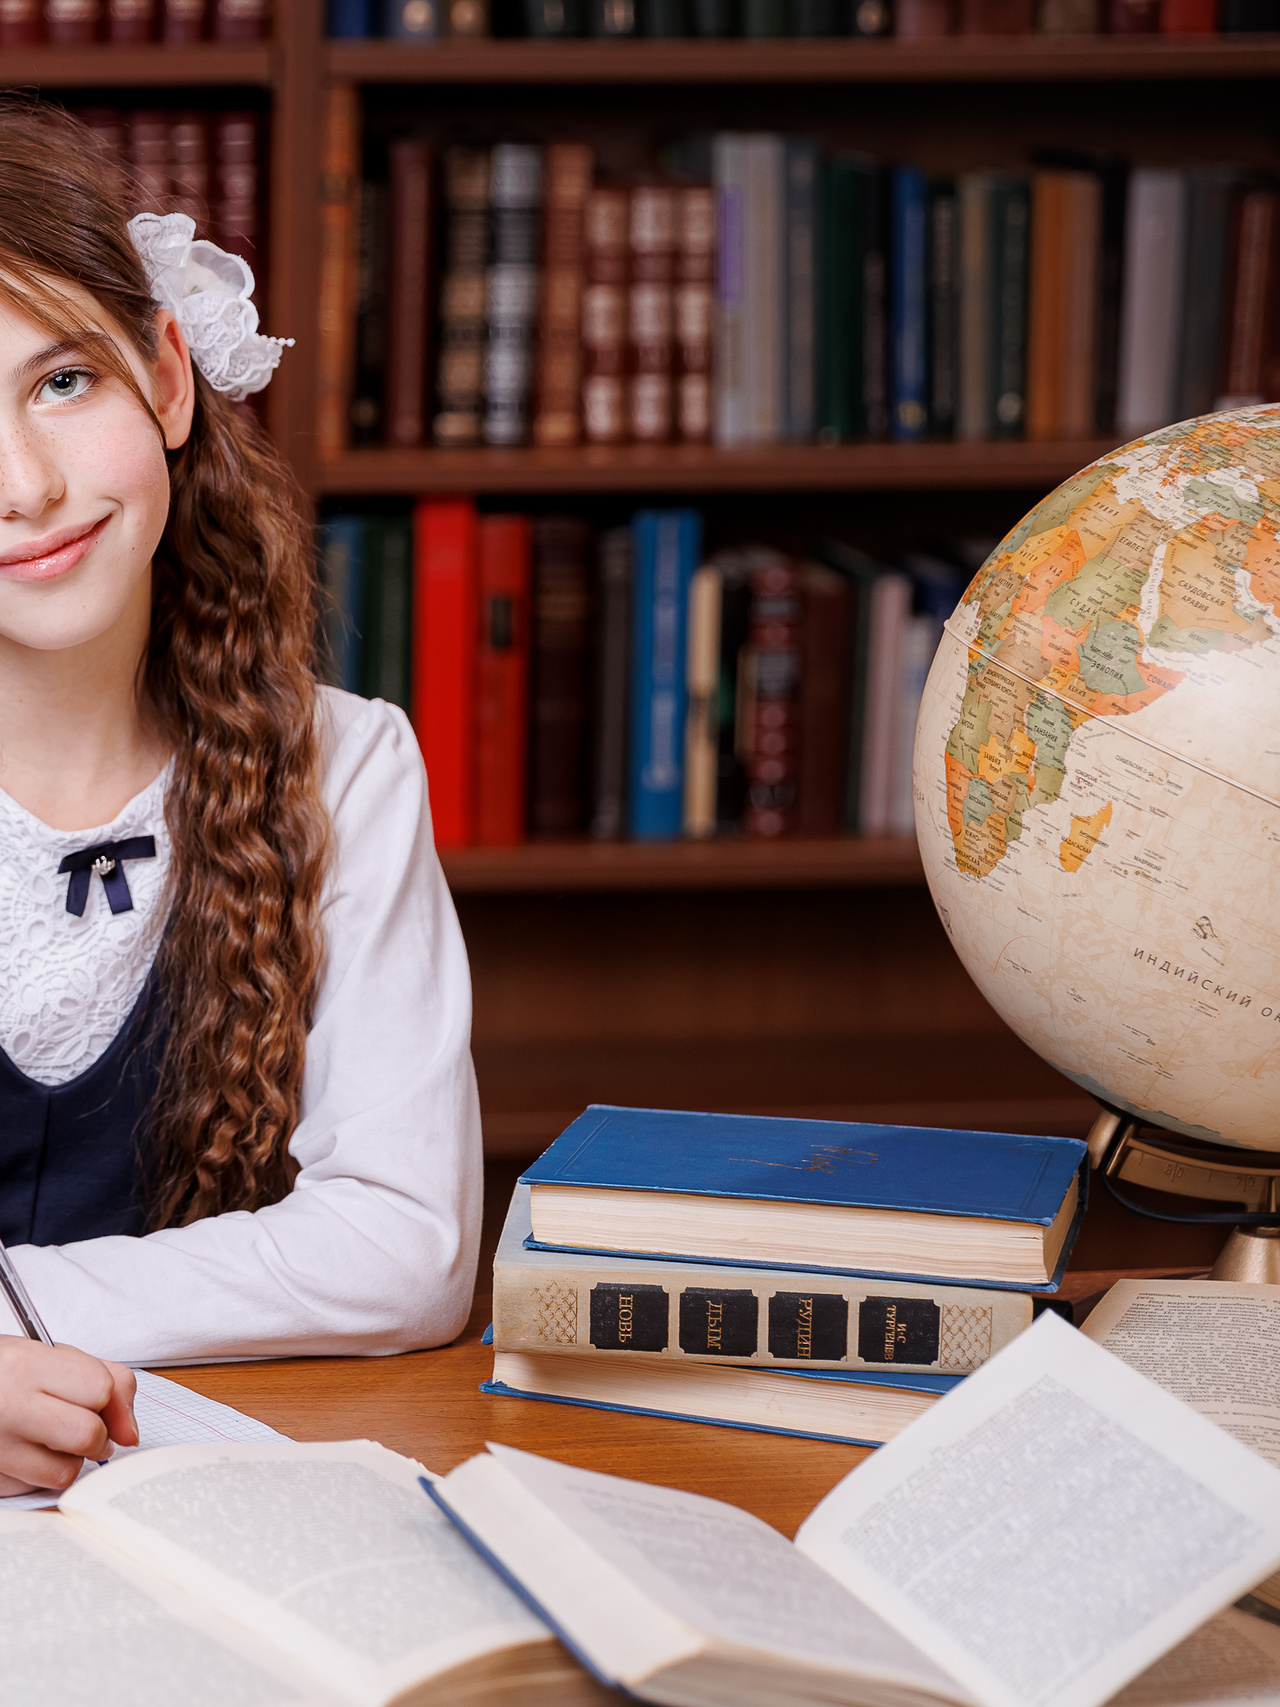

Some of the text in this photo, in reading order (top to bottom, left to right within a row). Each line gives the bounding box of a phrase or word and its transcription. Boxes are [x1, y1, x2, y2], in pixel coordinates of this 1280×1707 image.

[1205, 497, 1231, 511] ТУРЦИЯ
[1118, 536, 1146, 553] ЕГИПЕТ
[1215, 541, 1243, 557] ИРАК
[1177, 579, 1226, 608] САУДОВСКАЯ
[1070, 597, 1098, 617] СУДАН
[1181, 595, 1210, 613] АРАВИЯ
[1090, 660, 1125, 681] ЭФИОПИЯ
[1146, 674, 1176, 692] СОМАЛИ
[1060, 835, 1092, 855] МАДАГАСКАР
[1133, 947, 1252, 1008] ИНДИЙСКИЙ
[618, 1294, 633, 1343] НОВЬ
[706, 1301, 722, 1350] ДЫМ
[796, 1298, 814, 1358] РУДИН
[884, 1305, 897, 1361] ТУРГЕНЕВ
